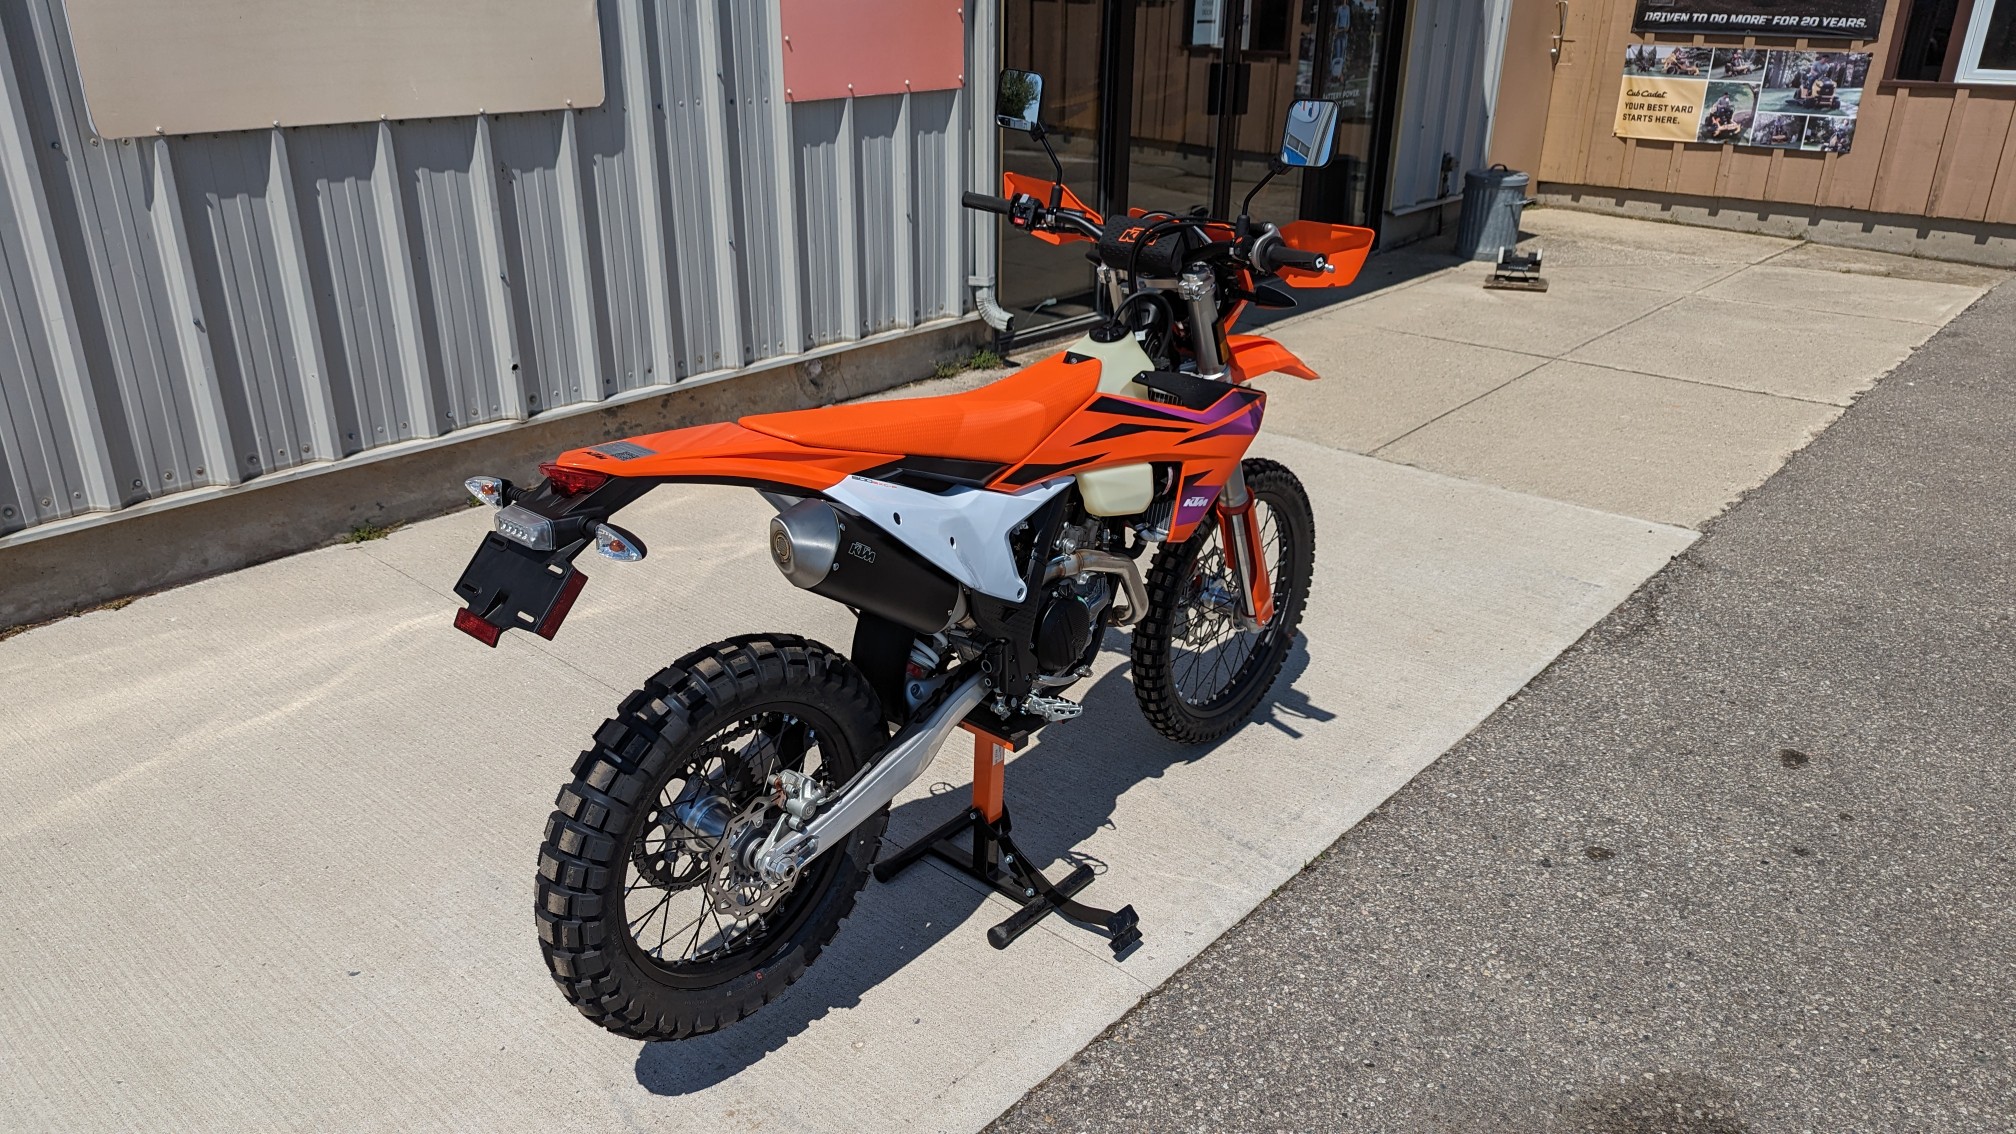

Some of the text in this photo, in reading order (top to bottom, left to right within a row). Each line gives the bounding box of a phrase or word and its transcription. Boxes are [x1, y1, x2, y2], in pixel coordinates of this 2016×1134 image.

[1644, 11, 1690, 23] DRIVEN
[1692, 13, 1708, 23] TO
[1709, 13, 1728, 24] DO
[1772, 15, 1799, 26] FOR
[1800, 16, 1820, 27] 20
[1822, 17, 1867, 28] YEARS.
[1626, 89, 1668, 98] Cub Cadet
[1624, 102, 1694, 114] YOUR BEST YARD
[1622, 113, 1680, 125] STARTS HERE.
[1183, 496, 1209, 507] KTM
[848, 541, 876, 564] KTM
